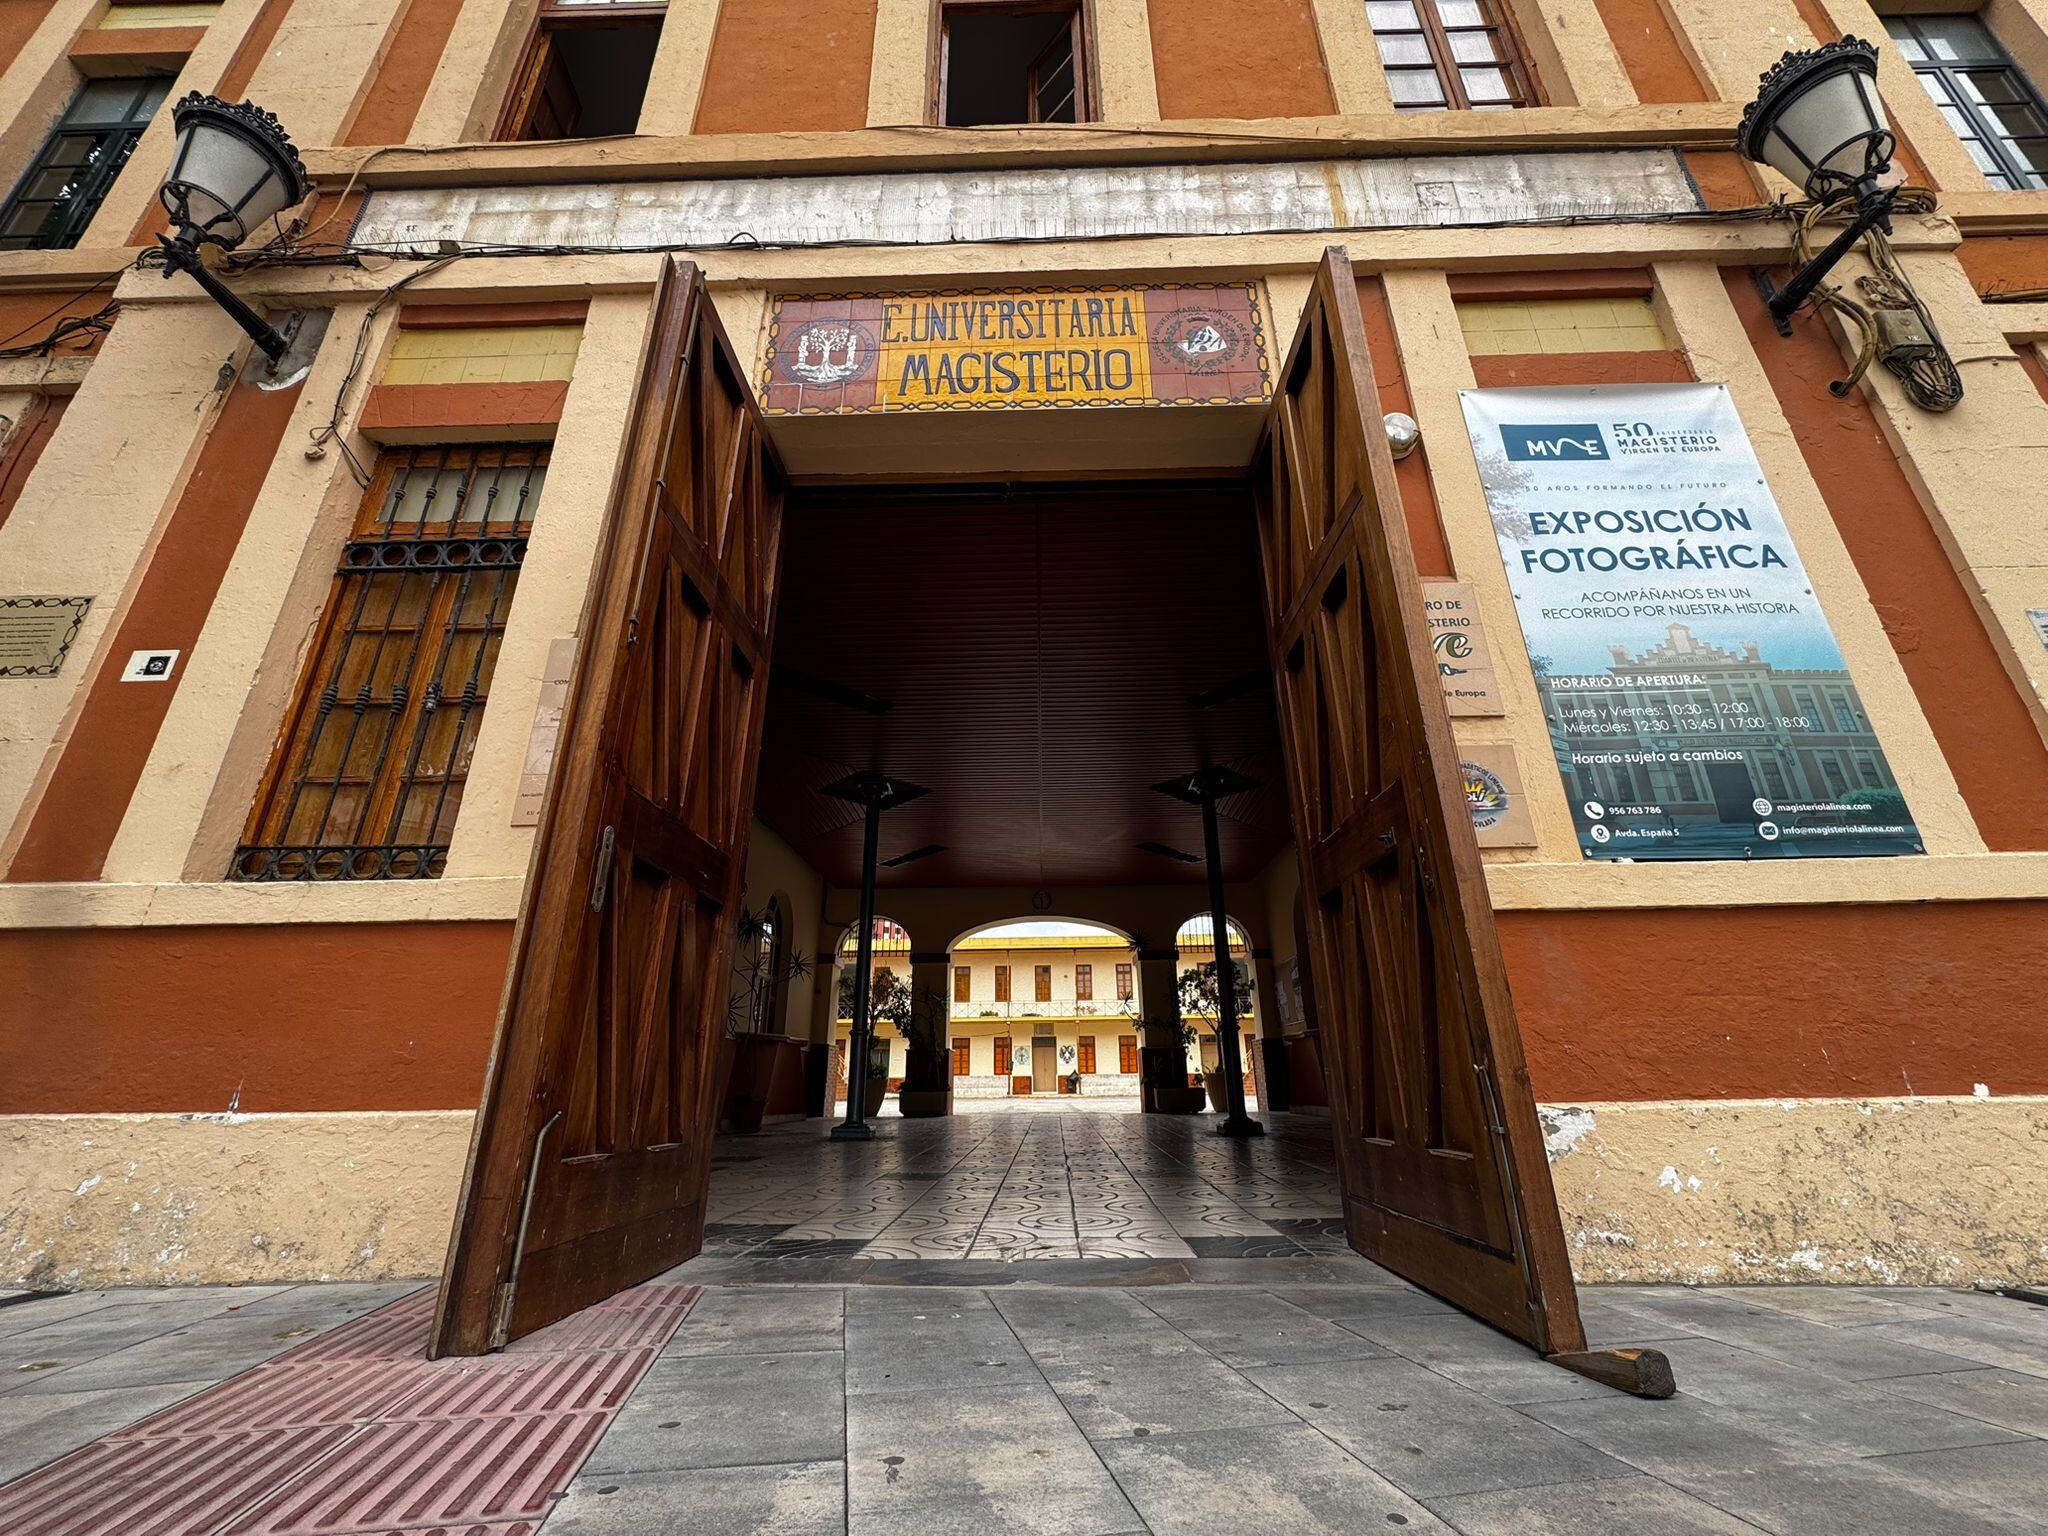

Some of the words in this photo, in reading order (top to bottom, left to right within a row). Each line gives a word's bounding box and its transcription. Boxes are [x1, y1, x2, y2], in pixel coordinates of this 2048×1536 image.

[881, 296, 1137, 344] E.UNIVERSITARIA
[898, 348, 1133, 397] MAGISTERIO
[1612, 422, 1653, 437] 50
[1617, 435, 1718, 448] MAGISTERIO
[1620, 447, 1659, 455] VIRGEN
[1682, 445, 1721, 453] EUROPA
[1547, 483, 1579, 491] AÑOS
[1586, 483, 1652, 491] FORMANDO
[1680, 481, 1727, 489] FUTURO
[1528, 502, 1752, 536] EXPOSICIÓN
[1520, 539, 1788, 574] FOTOGRÁFICA
[1581, 588, 1704, 603] ACOMPÁÑANOS
[1707, 588, 1727, 599] EN
[1729, 588, 1751, 599] UN
[1445, 600, 1462, 610] DE
[1541, 607, 1631, 620] RECORRIDO
[1634, 605, 1666, 617] POR
[1670, 604, 1733, 616] NUESTRA
[1736, 602, 1800, 615] HISTORIA
[1550, 677, 1612, 689] HORARIO
[1615, 676, 1632, 688] DE
[1635, 674, 1707, 687] APERTURA:
[1455, 689, 1486, 698] Europa
[1558, 706, 1596, 719] Lunes
[1598, 709, 1607, 720] y
[1609, 704, 1664, 718] Viernes:
[1667, 703, 1702, 716] 10:30
[1713, 702, 1749, 714] 12:00
[1563, 720, 1631, 733] Miércoles:
[1634, 719, 1669, 731] 12:30
[1681, 718, 1717, 730] 13:45
[1729, 717, 1765, 729] 17:00
[1775, 716, 1810, 728] 18:00
[1571, 752, 1622, 764] Horario
[1624, 751, 1667, 766] sujeto
[1669, 753, 1680, 762] a
[1682, 749, 1743, 762] cambios
[1777, 802, 1872, 813] magisteriolalinea.com
[1782, 823, 1904, 836] info@magisteriolalinea.com
